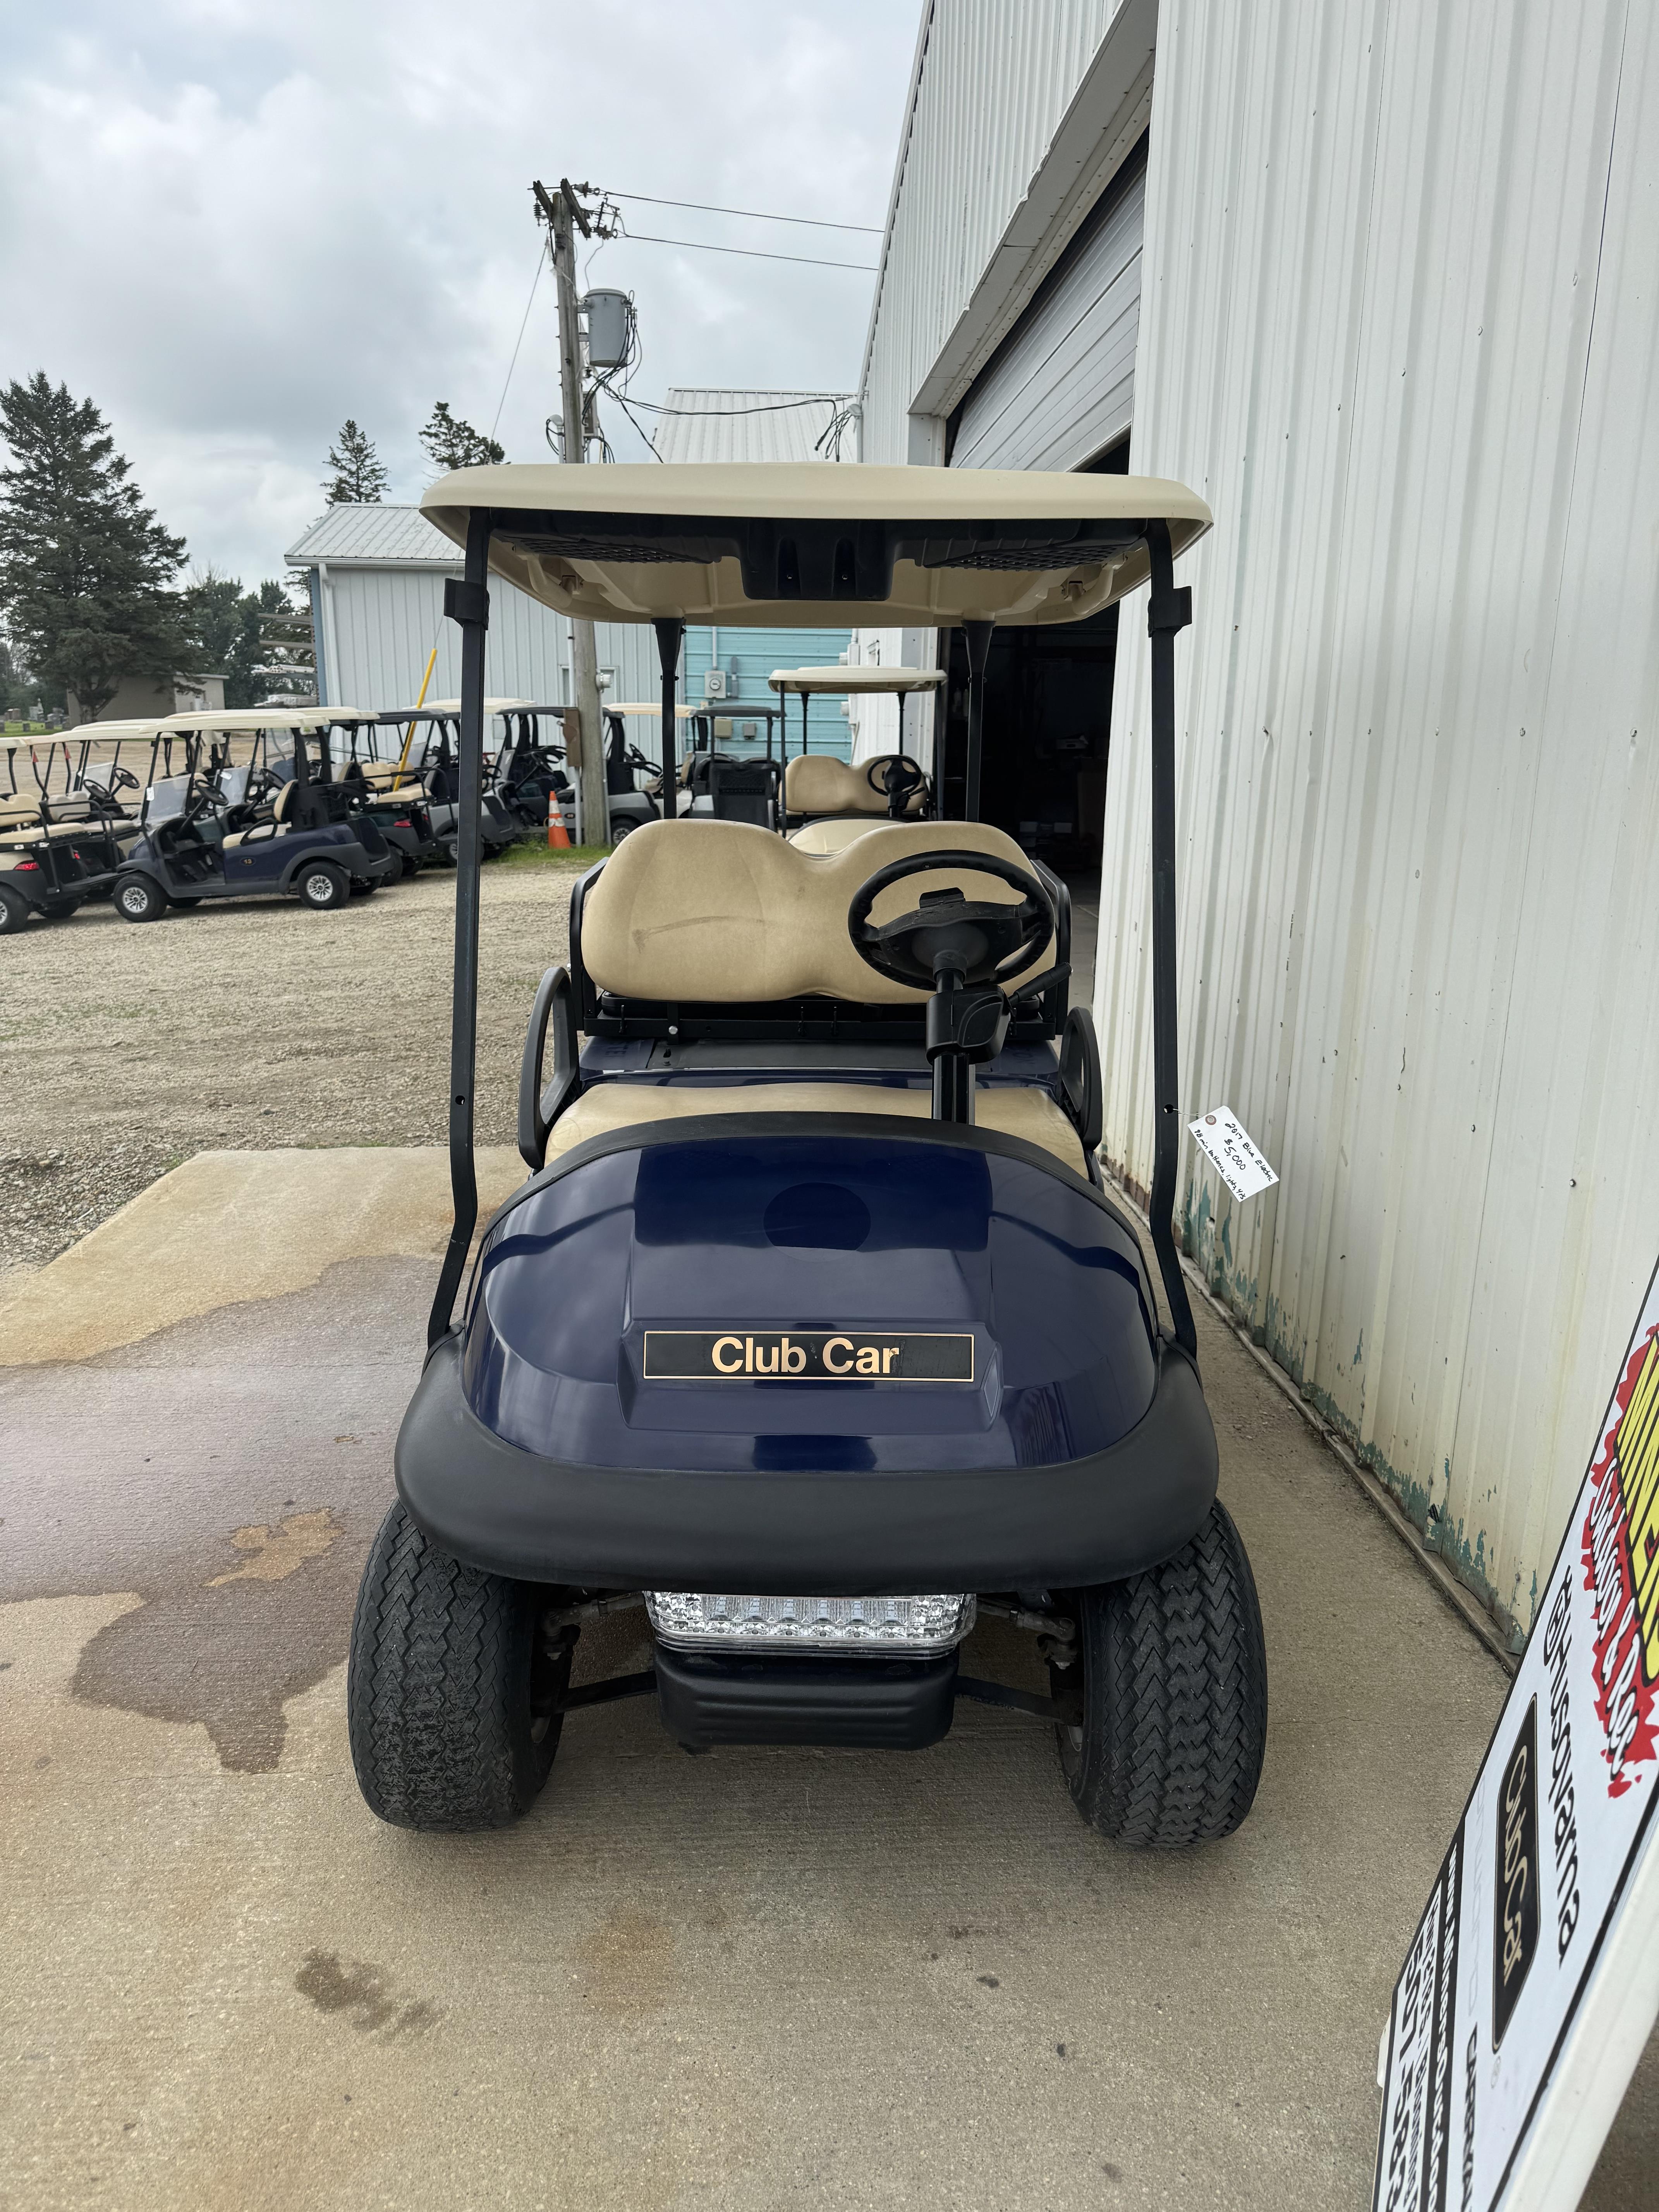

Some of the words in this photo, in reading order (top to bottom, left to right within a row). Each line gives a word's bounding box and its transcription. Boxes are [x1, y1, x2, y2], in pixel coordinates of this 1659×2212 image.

[1194, 1129, 1203, 1138] 98
[1199, 1139, 1208, 1149] min
[1224, 1139, 1246, 1170] $5,000
[1225, 1123, 1243, 1139] 2017
[1242, 1142, 1254, 1158] Blue
[712, 1336, 806, 1373] Club
[822, 1337, 899, 1374] Car
[1590, 1458, 1625, 1641] Outdoor
[1602, 1597, 1635, 1685] &
[1607, 1633, 1640, 1776] Rec
[1504, 1745, 1527, 1884] Club
[1549, 1612, 1580, 1969] Husqvarna
[1421, 1946, 1435, 2010] 218
[1422, 1893, 1439, 1966] Hwy
[1504, 1856, 1527, 1987] Car
[1427, 1843, 1457, 2212] www.MinersOutdoo
[1403, 2047, 1428, 2207] Blooming
[1461, 2021, 1477, 2212] CARRYAL
